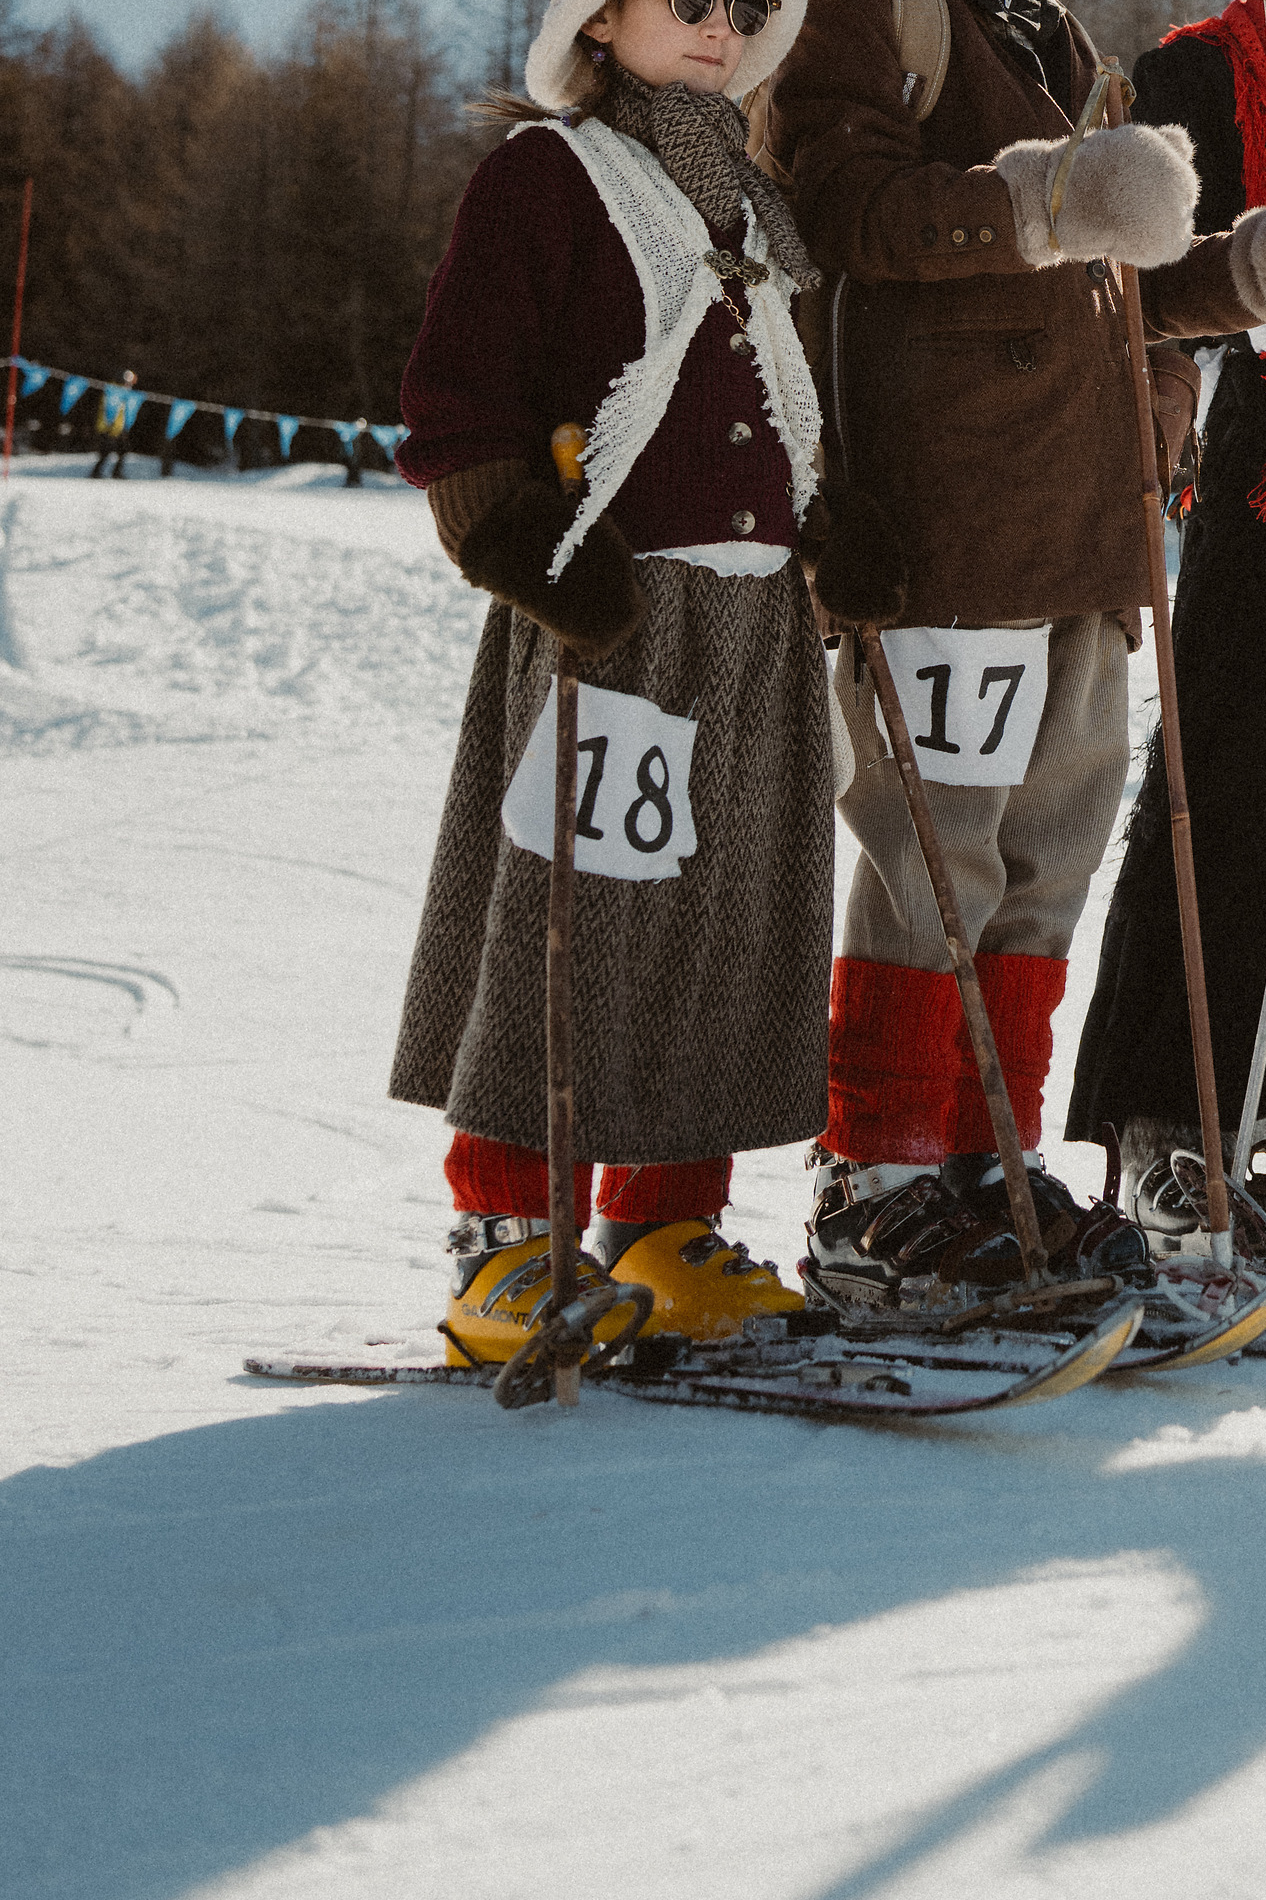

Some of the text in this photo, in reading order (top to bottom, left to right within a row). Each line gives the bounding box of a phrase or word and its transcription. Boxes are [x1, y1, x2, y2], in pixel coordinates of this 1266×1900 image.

[915, 663, 1026, 756] 17
[576, 735, 674, 854] 18
[461, 1303, 529, 1325] GAMONT
